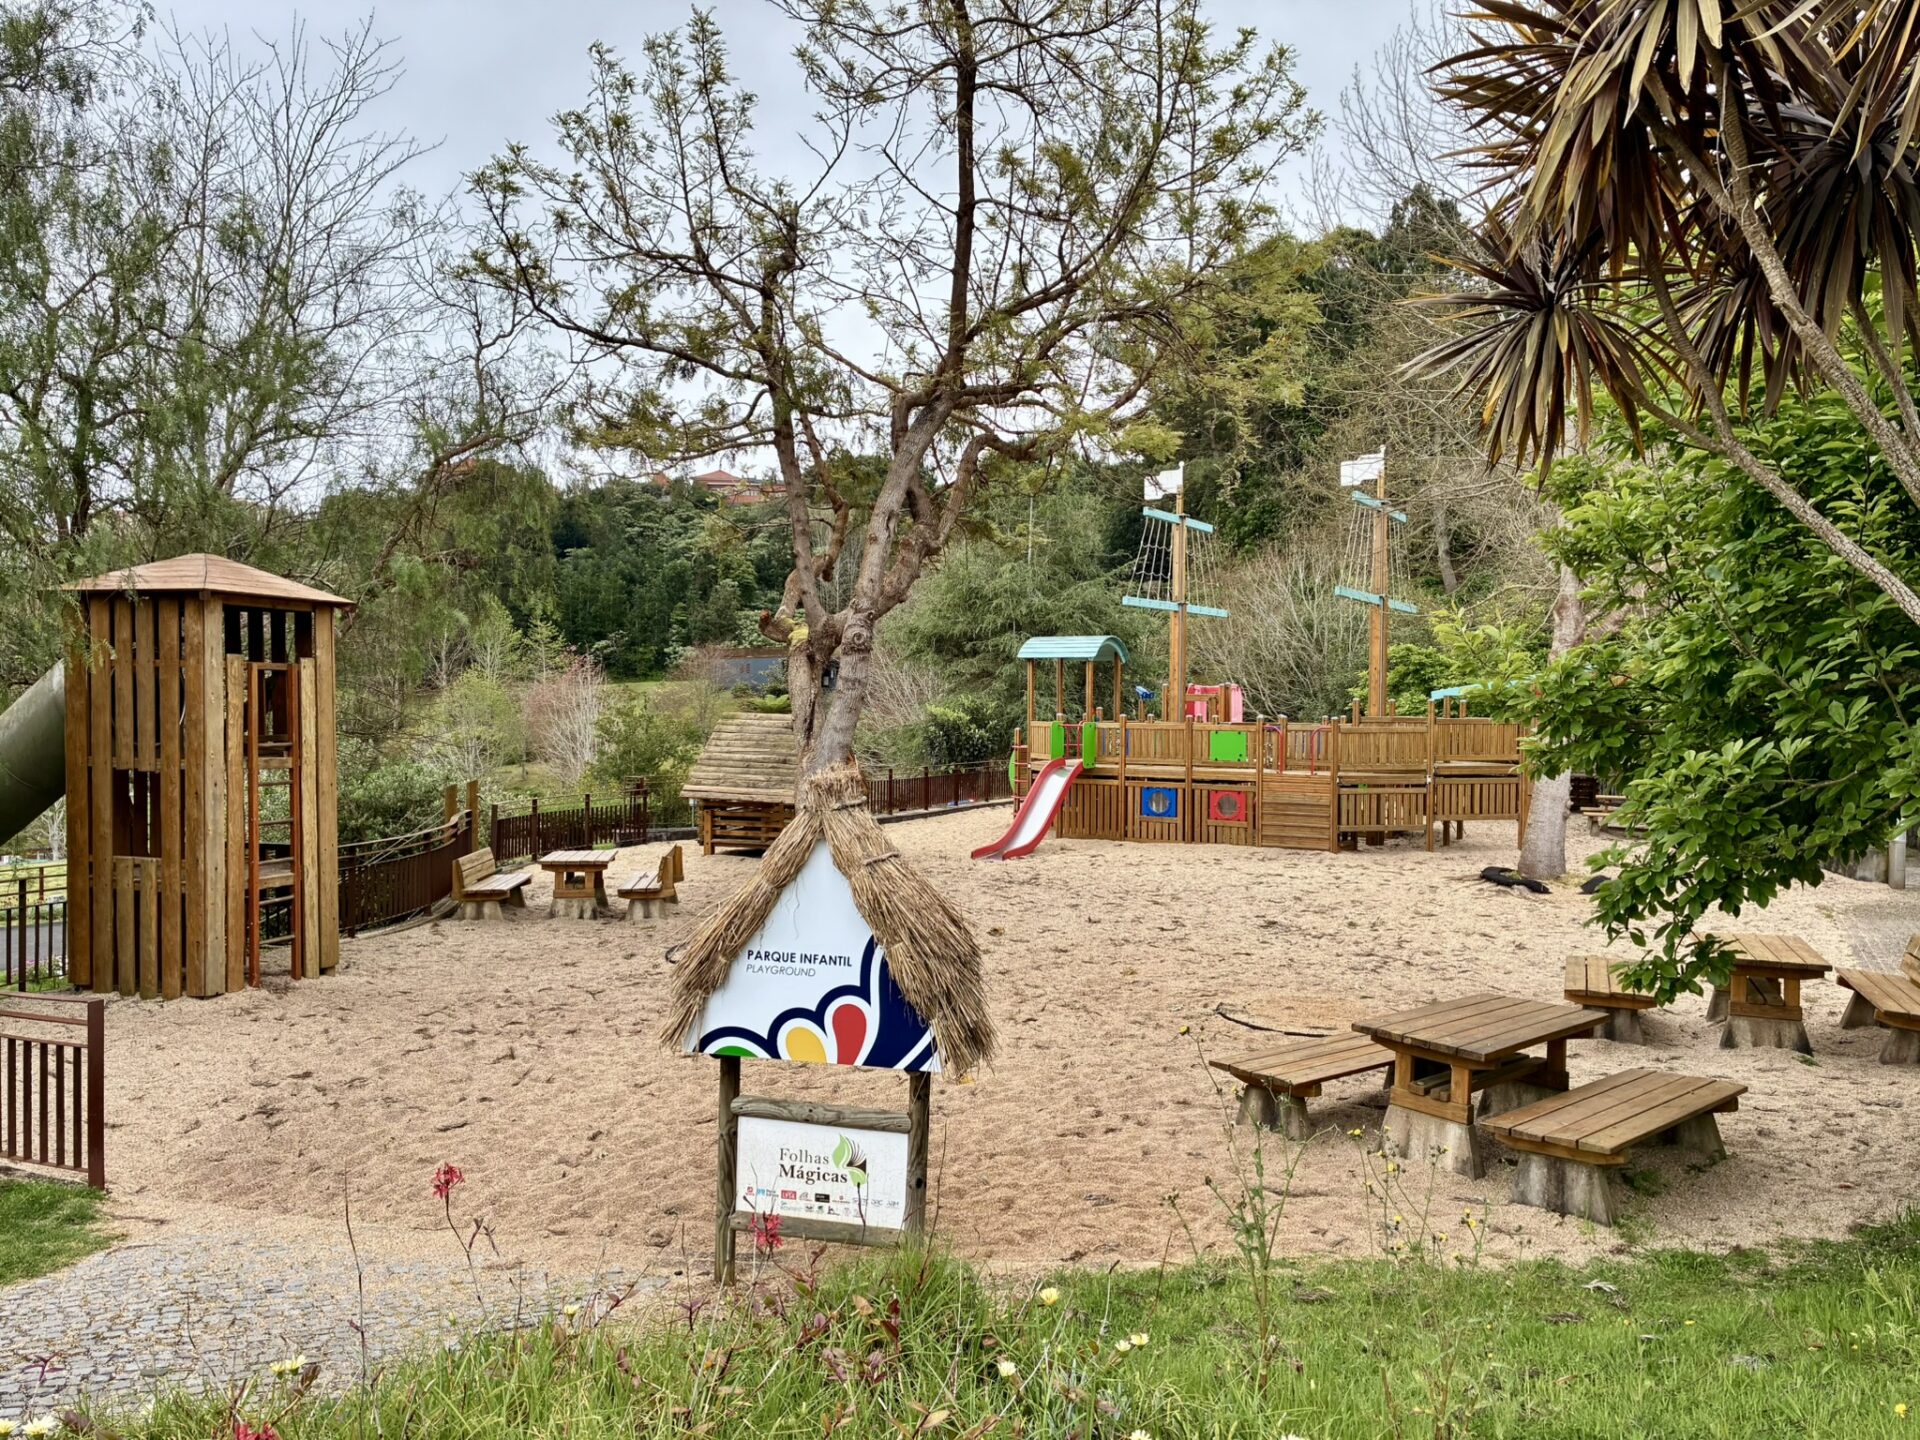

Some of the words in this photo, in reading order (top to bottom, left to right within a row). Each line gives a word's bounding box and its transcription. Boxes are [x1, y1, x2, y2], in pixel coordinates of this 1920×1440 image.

[747, 949, 796, 964] PARQUE
[800, 953, 852, 967] INFANTIL
[746, 963, 816, 977] PLAYGROUND
[780, 1147, 829, 1165] Folhas
[779, 1164, 848, 1185] Mágicas
